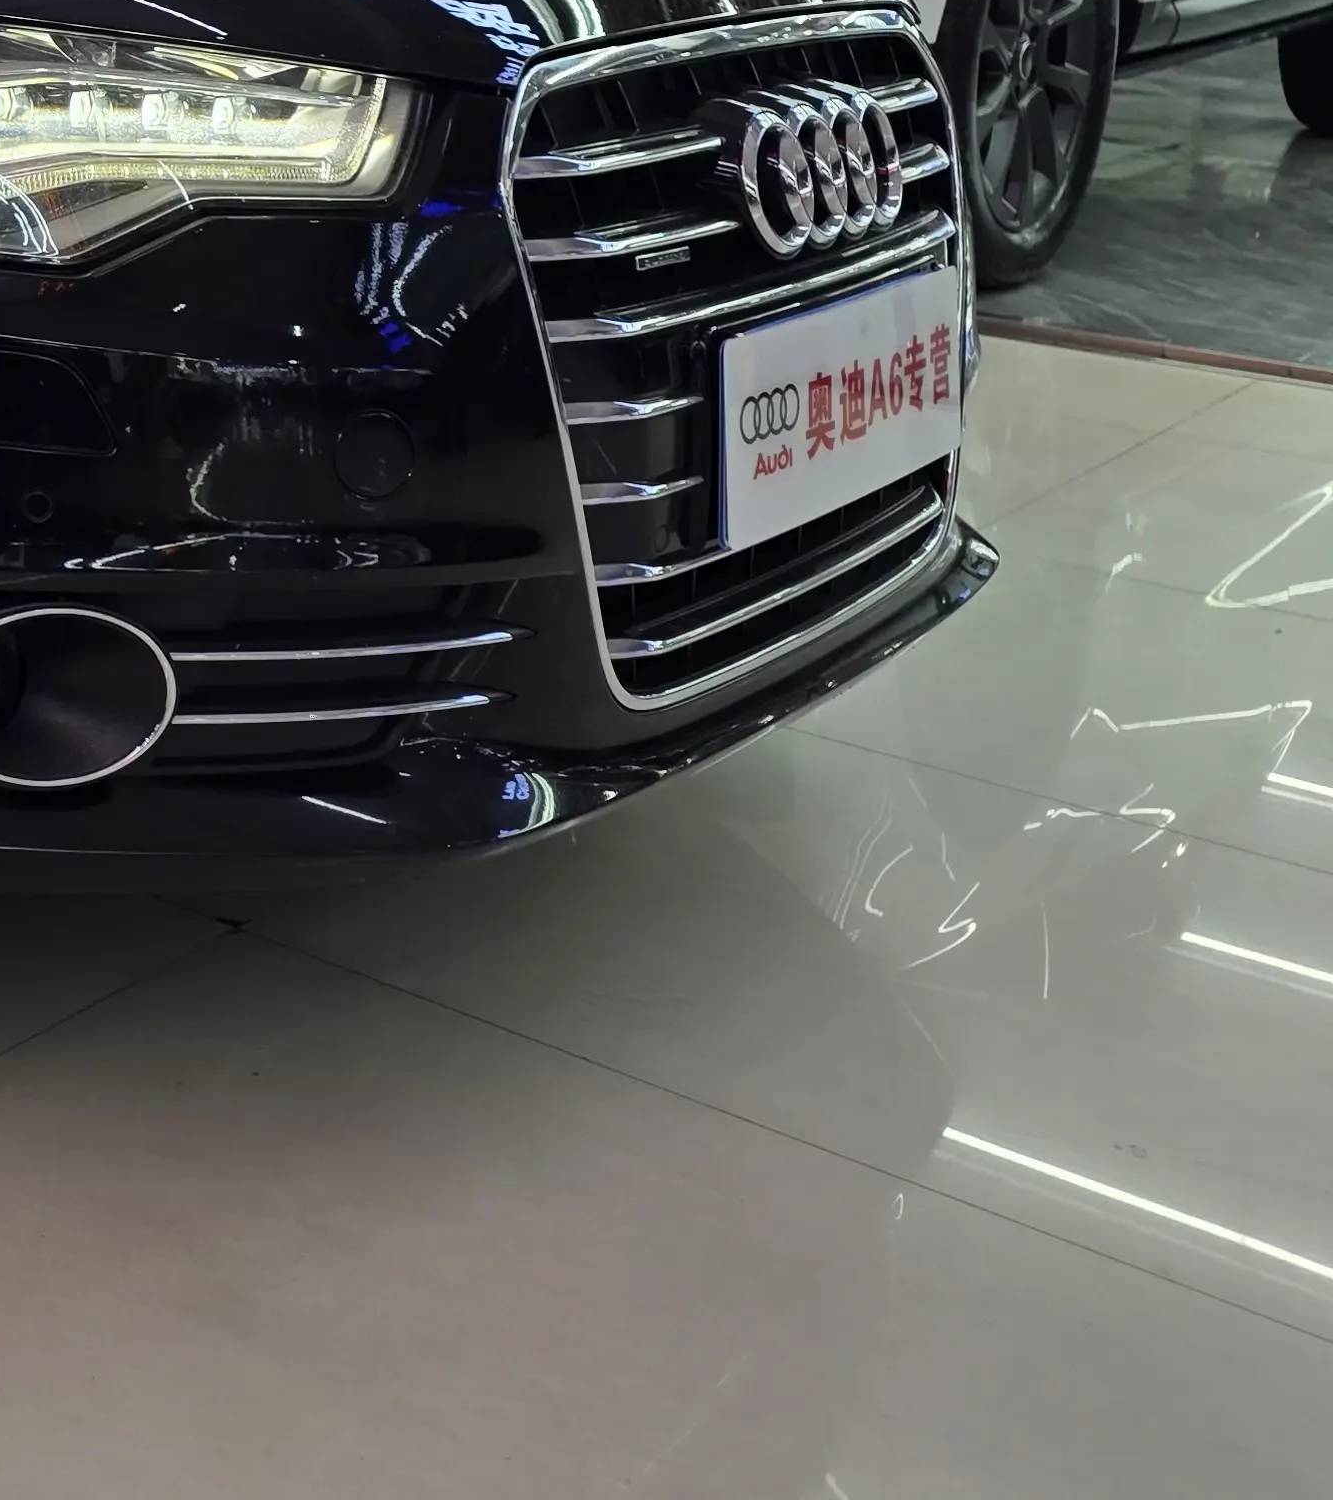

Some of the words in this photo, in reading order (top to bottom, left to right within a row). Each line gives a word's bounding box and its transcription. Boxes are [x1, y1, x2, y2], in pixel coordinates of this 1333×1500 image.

[806, 324, 951, 460] 奥迪A6专营
[753, 444, 794, 481] Audi
